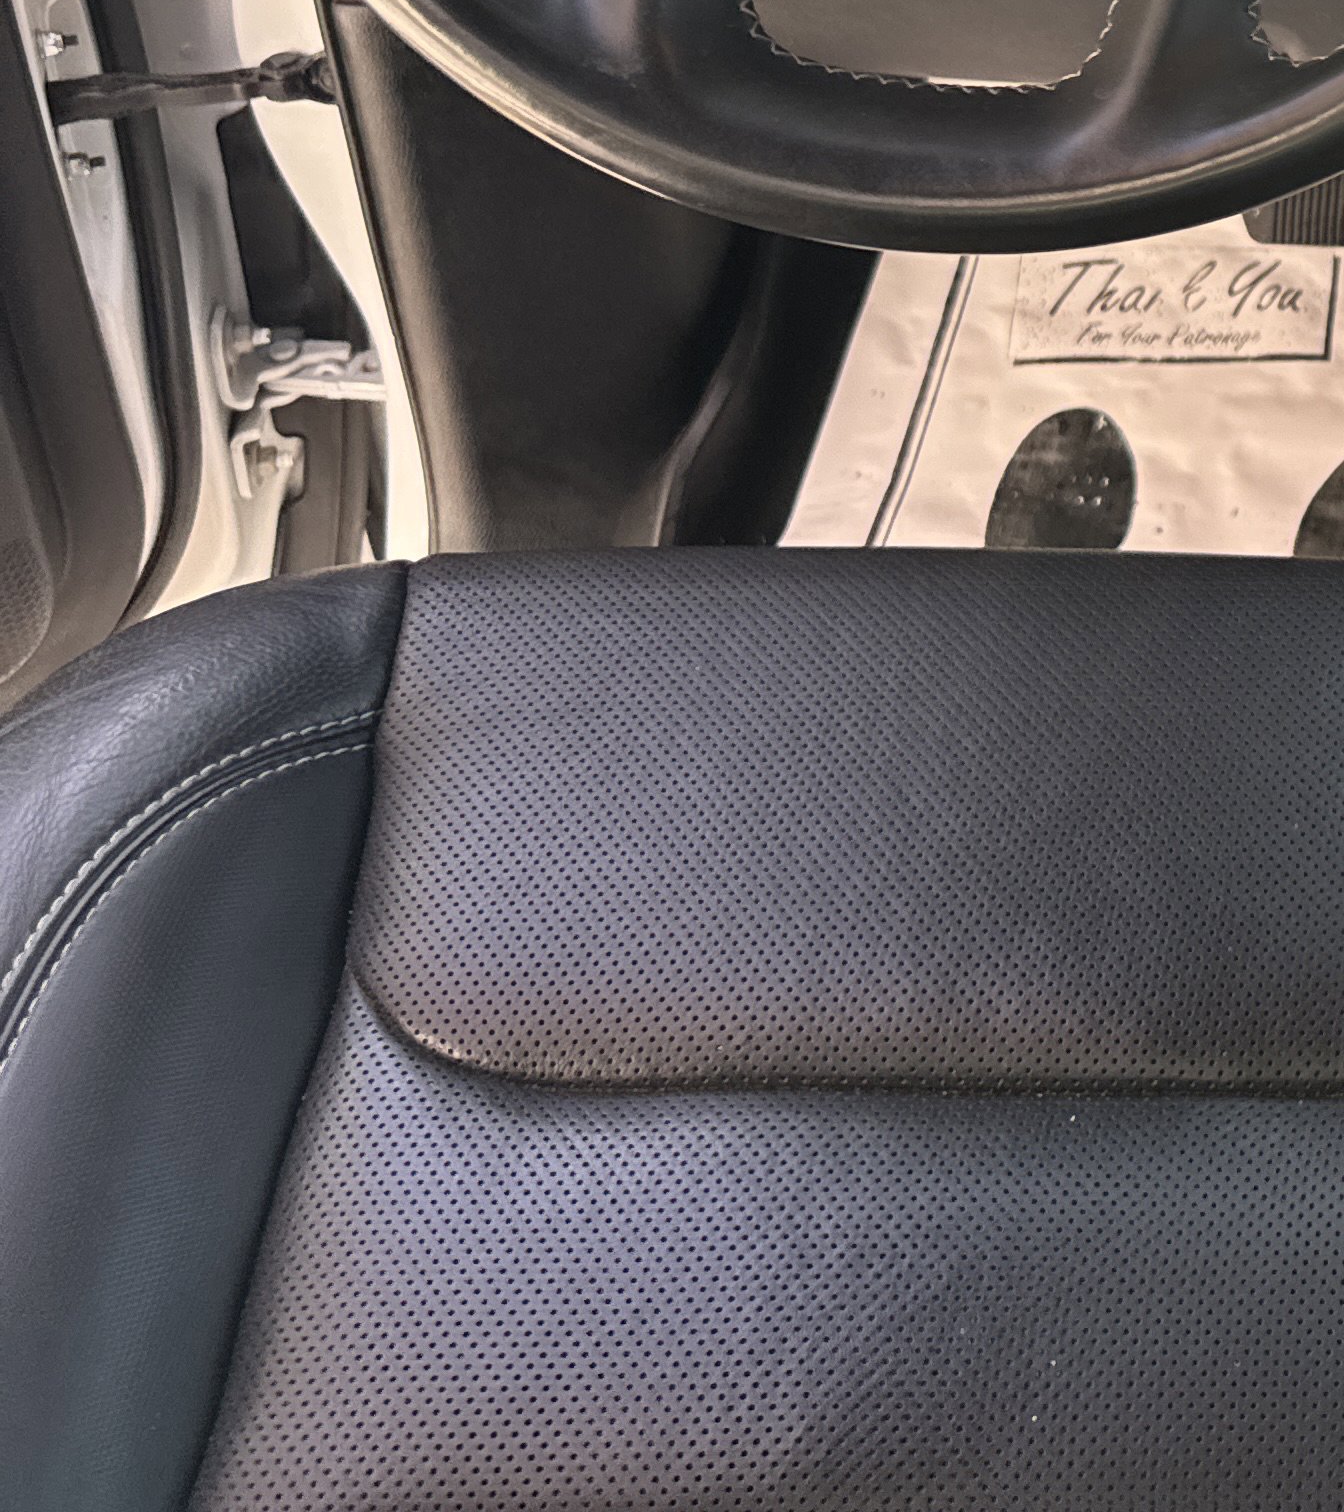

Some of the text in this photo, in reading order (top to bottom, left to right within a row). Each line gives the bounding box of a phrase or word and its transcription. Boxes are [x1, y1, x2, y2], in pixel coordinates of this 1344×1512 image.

[1228, 258, 1302, 319] You
[1076, 322, 1261, 351] For Your Patronage
